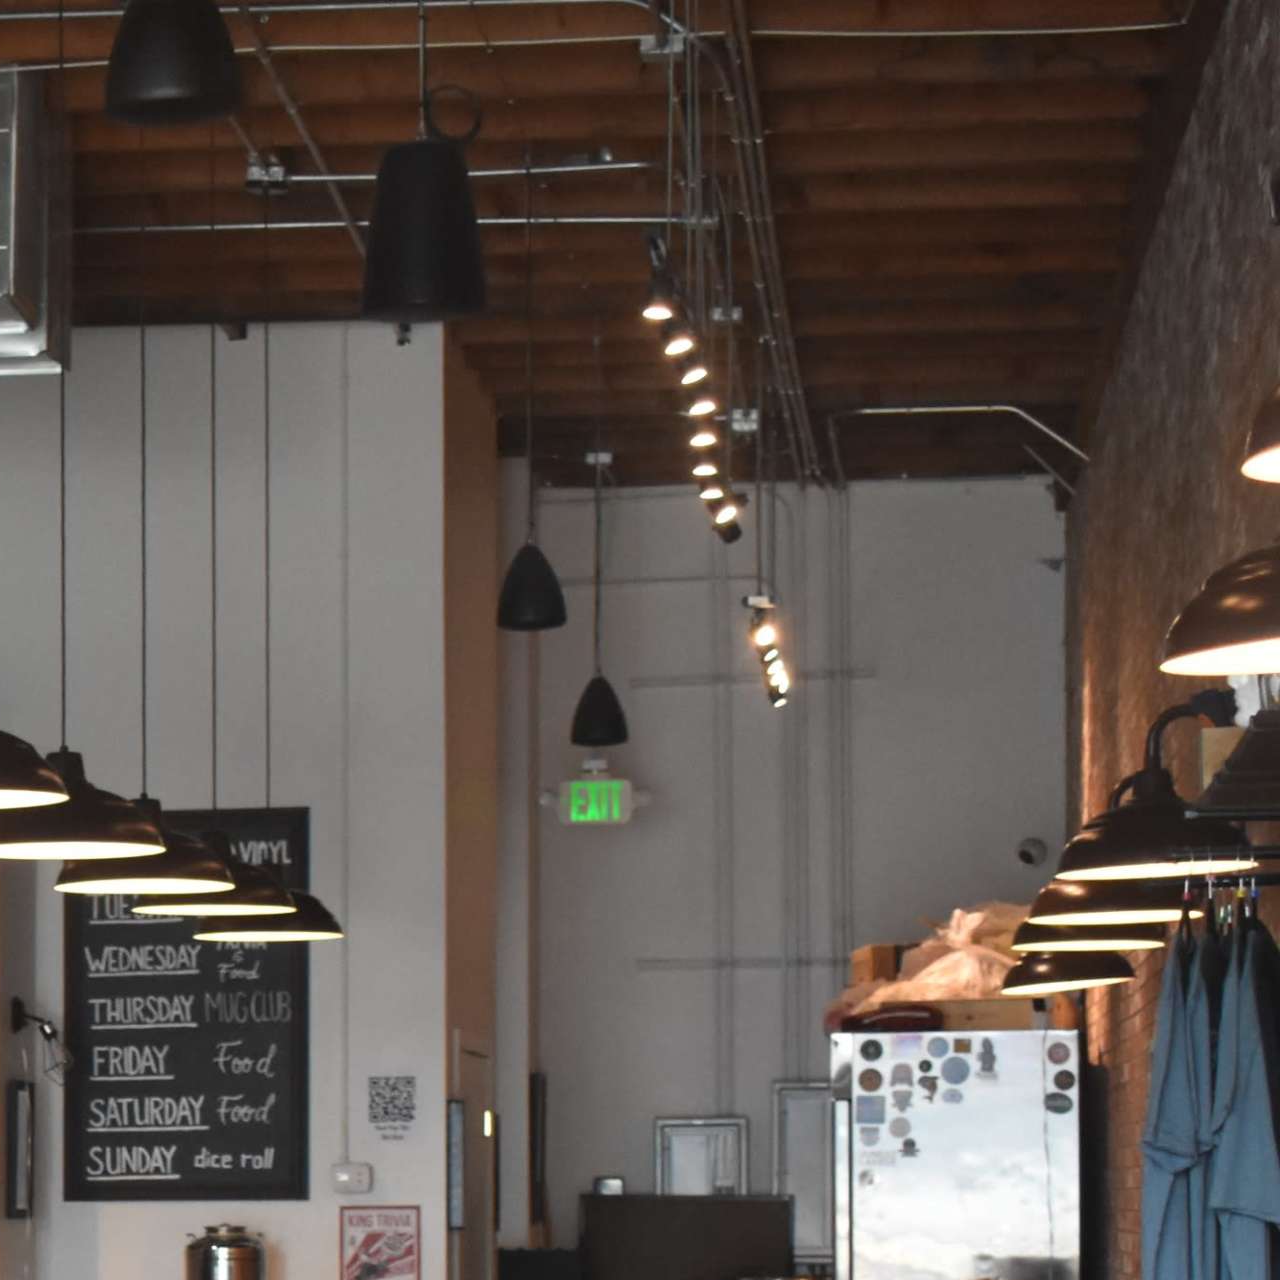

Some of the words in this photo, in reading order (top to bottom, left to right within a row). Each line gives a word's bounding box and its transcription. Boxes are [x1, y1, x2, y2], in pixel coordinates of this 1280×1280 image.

[570, 780, 624, 822] EXIT
[84, 945, 202, 973] WEDNESDAY
[217, 961, 261, 983] Food
[88, 995, 195, 1024] THURSDAY
[204, 992, 248, 1024] MUG
[250, 991, 291, 1023] CLUB
[93, 1044, 170, 1077] FRIDAY
[213, 1040, 277, 1078] Food
[89, 1095, 205, 1127] SATURDAY
[216, 1093, 276, 1124] Food
[87, 1146, 177, 1175] SUNDAY
[194, 1147, 233, 1169] dice
[241, 1147, 275, 1170] roll
